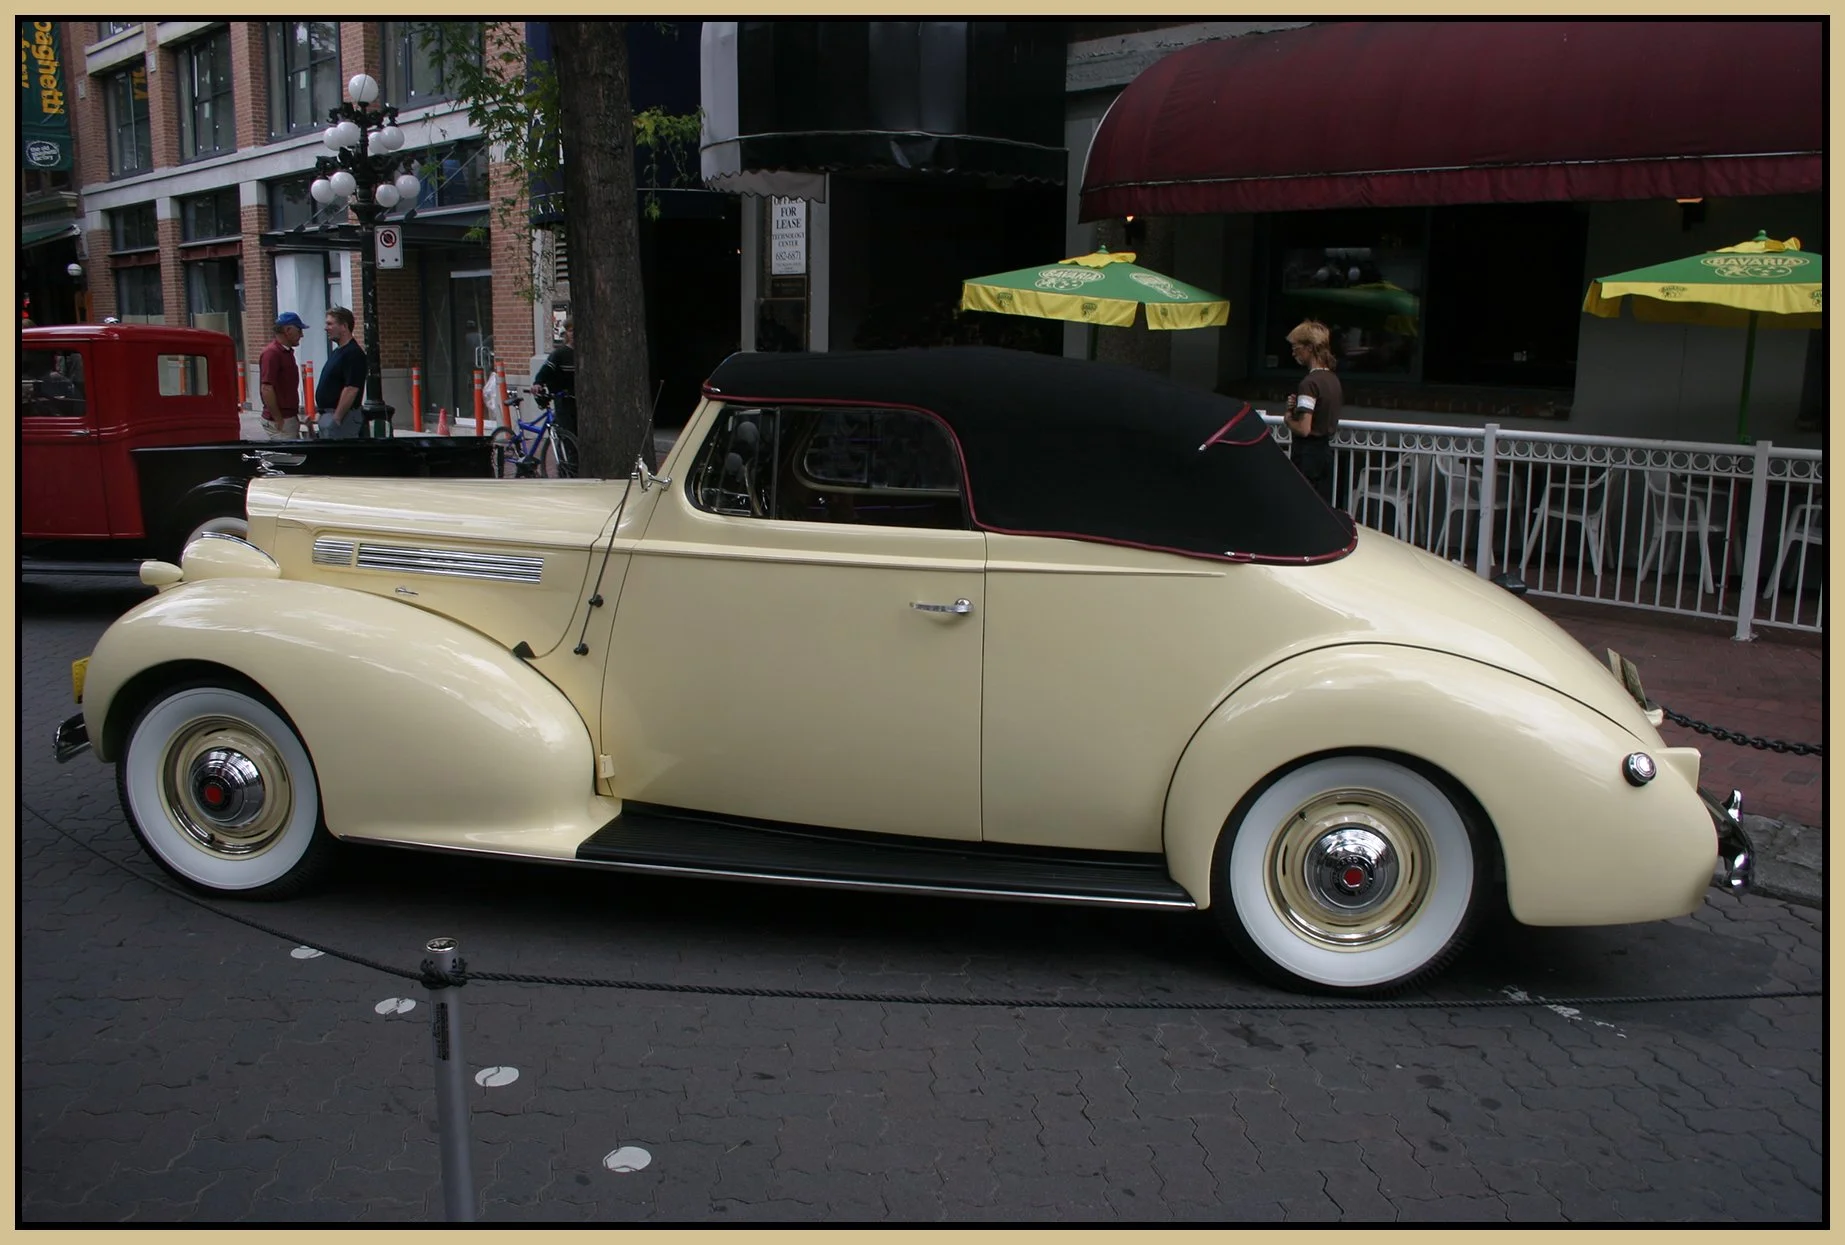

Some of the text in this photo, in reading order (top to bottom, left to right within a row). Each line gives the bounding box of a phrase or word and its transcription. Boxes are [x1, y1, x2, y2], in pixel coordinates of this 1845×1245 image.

[781, 207, 797, 217] FOR
[776, 219, 801, 229] LEASE
[772, 232, 805, 240] TECHNOLOGY
[1710, 256, 1801, 266] BAVARIA
